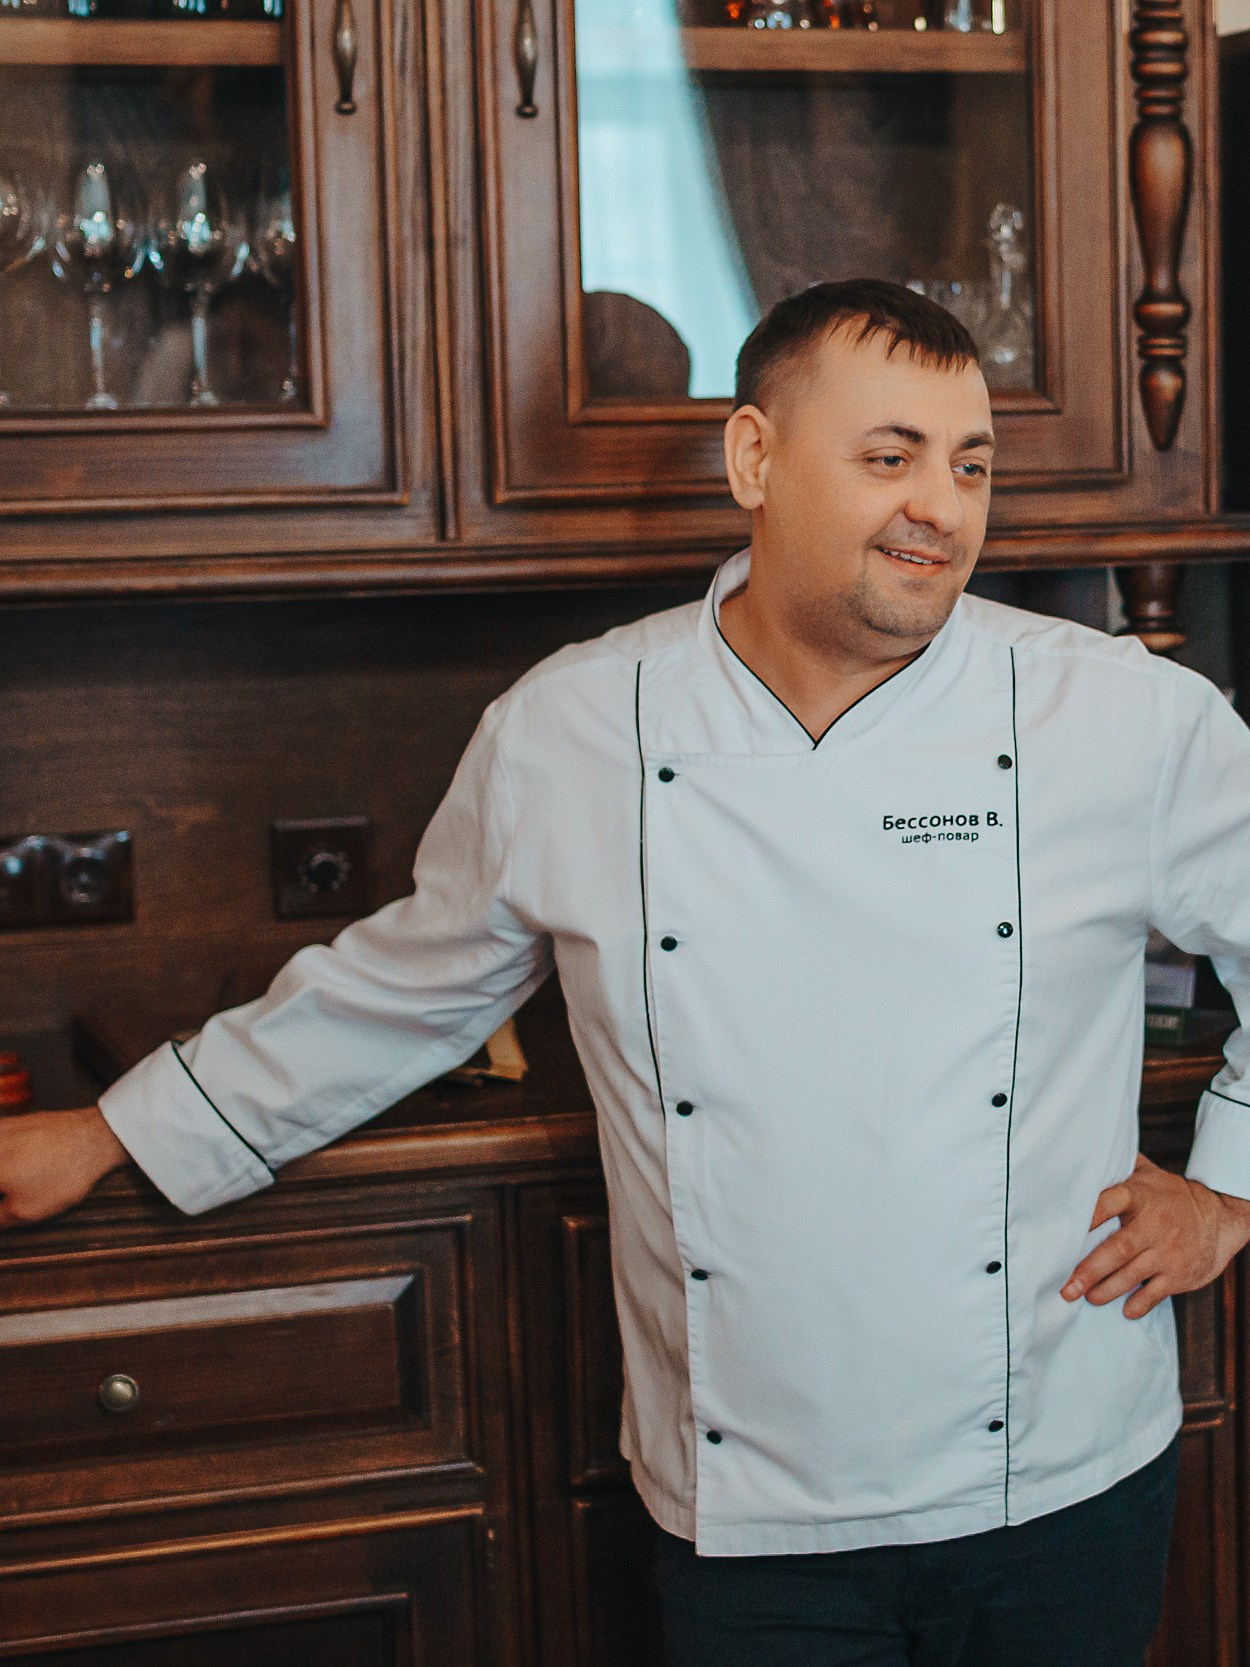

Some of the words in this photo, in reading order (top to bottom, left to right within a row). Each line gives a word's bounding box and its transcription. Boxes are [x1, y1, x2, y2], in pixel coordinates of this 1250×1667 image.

[883, 814, 979, 831] Бессонов
[986, 811, 1003, 827] В.
[902, 831, 979, 844] шеф-повар
